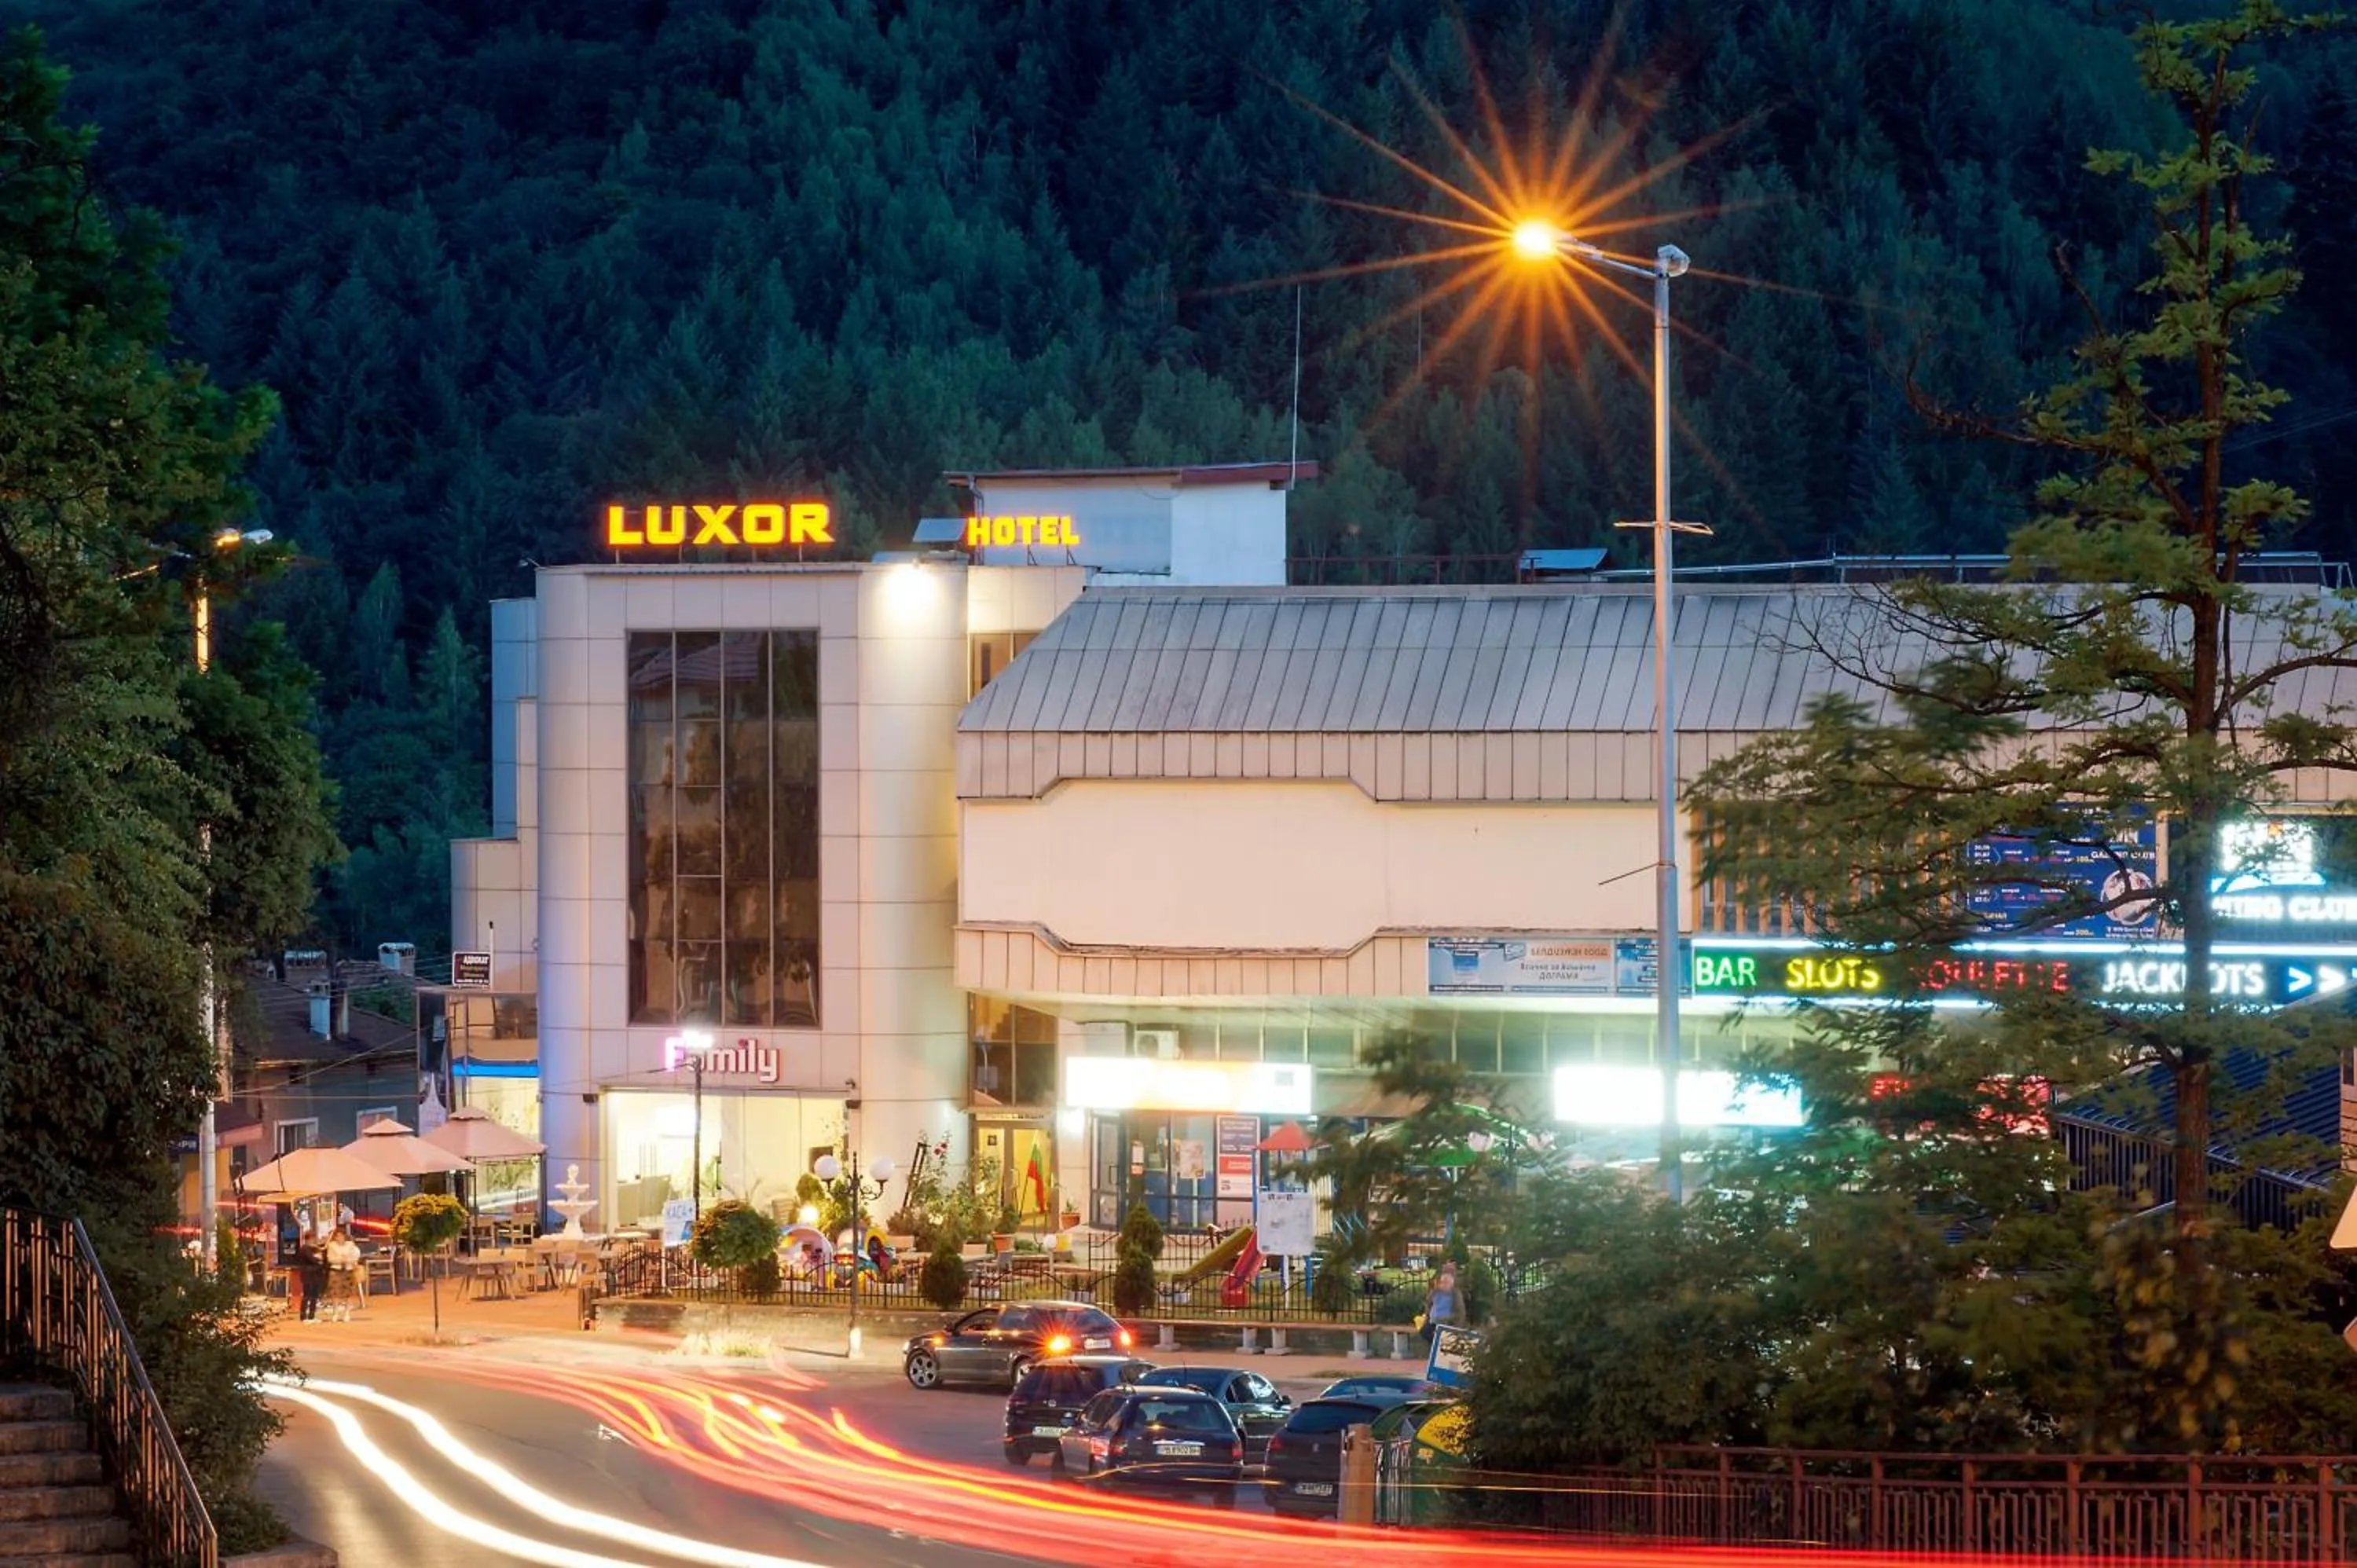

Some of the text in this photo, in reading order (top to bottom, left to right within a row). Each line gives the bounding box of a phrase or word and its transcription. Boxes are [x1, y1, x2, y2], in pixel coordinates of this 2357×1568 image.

[608, 502, 1080, 546] LUXOR HOTEL
[1695, 958, 1757, 987] BAR
[1787, 958, 1880, 988] SLOTS
[2102, 962, 2264, 995] JACKOTS
